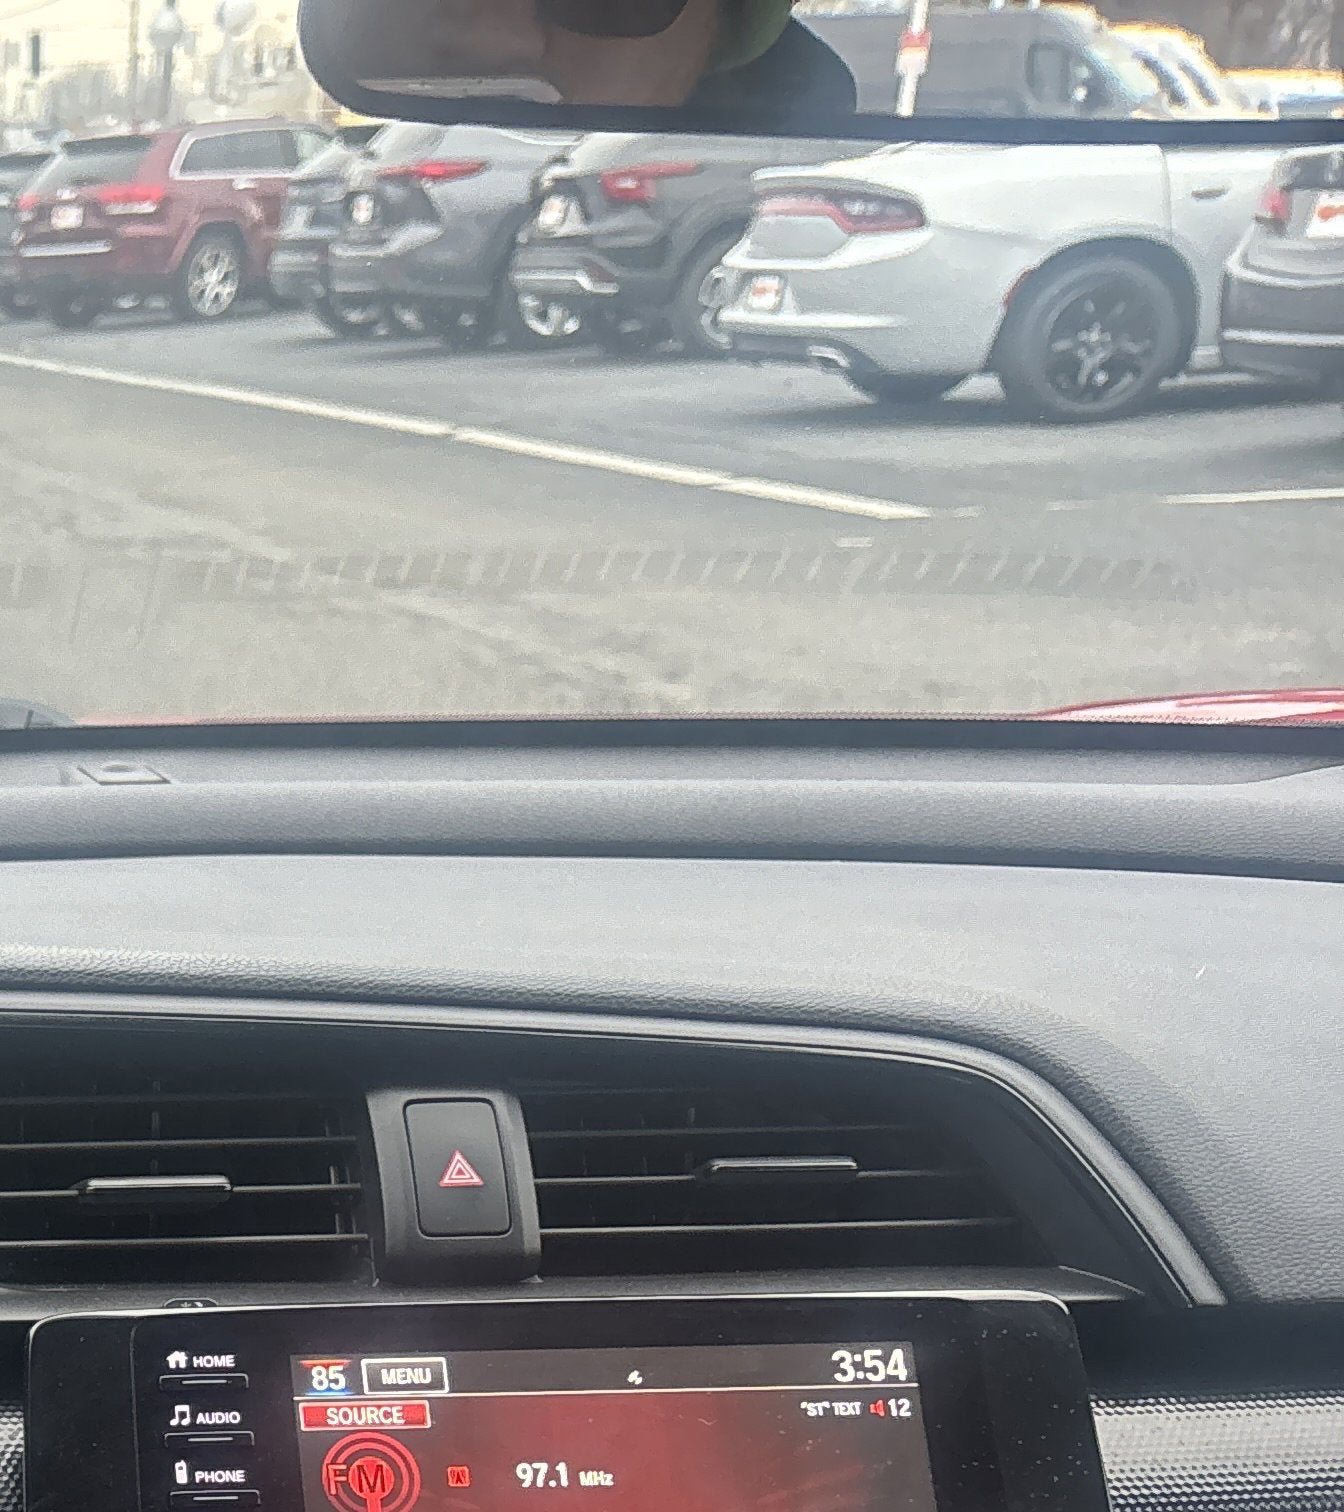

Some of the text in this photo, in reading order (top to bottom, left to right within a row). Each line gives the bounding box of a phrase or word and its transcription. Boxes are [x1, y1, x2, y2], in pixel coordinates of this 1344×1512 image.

[192, 1354, 236, 1368] HOME
[312, 1347, 907, 1391] 85 MENU 3:54
[326, 1405, 405, 1427] SOURCE
[832, 1401, 862, 1417] TEXT
[888, 1398, 912, 1418] 12
[195, 1410, 241, 1425] AUDIO
[194, 1469, 246, 1483] PHONE
[515, 1462, 614, 1488] 97.1 MHz
